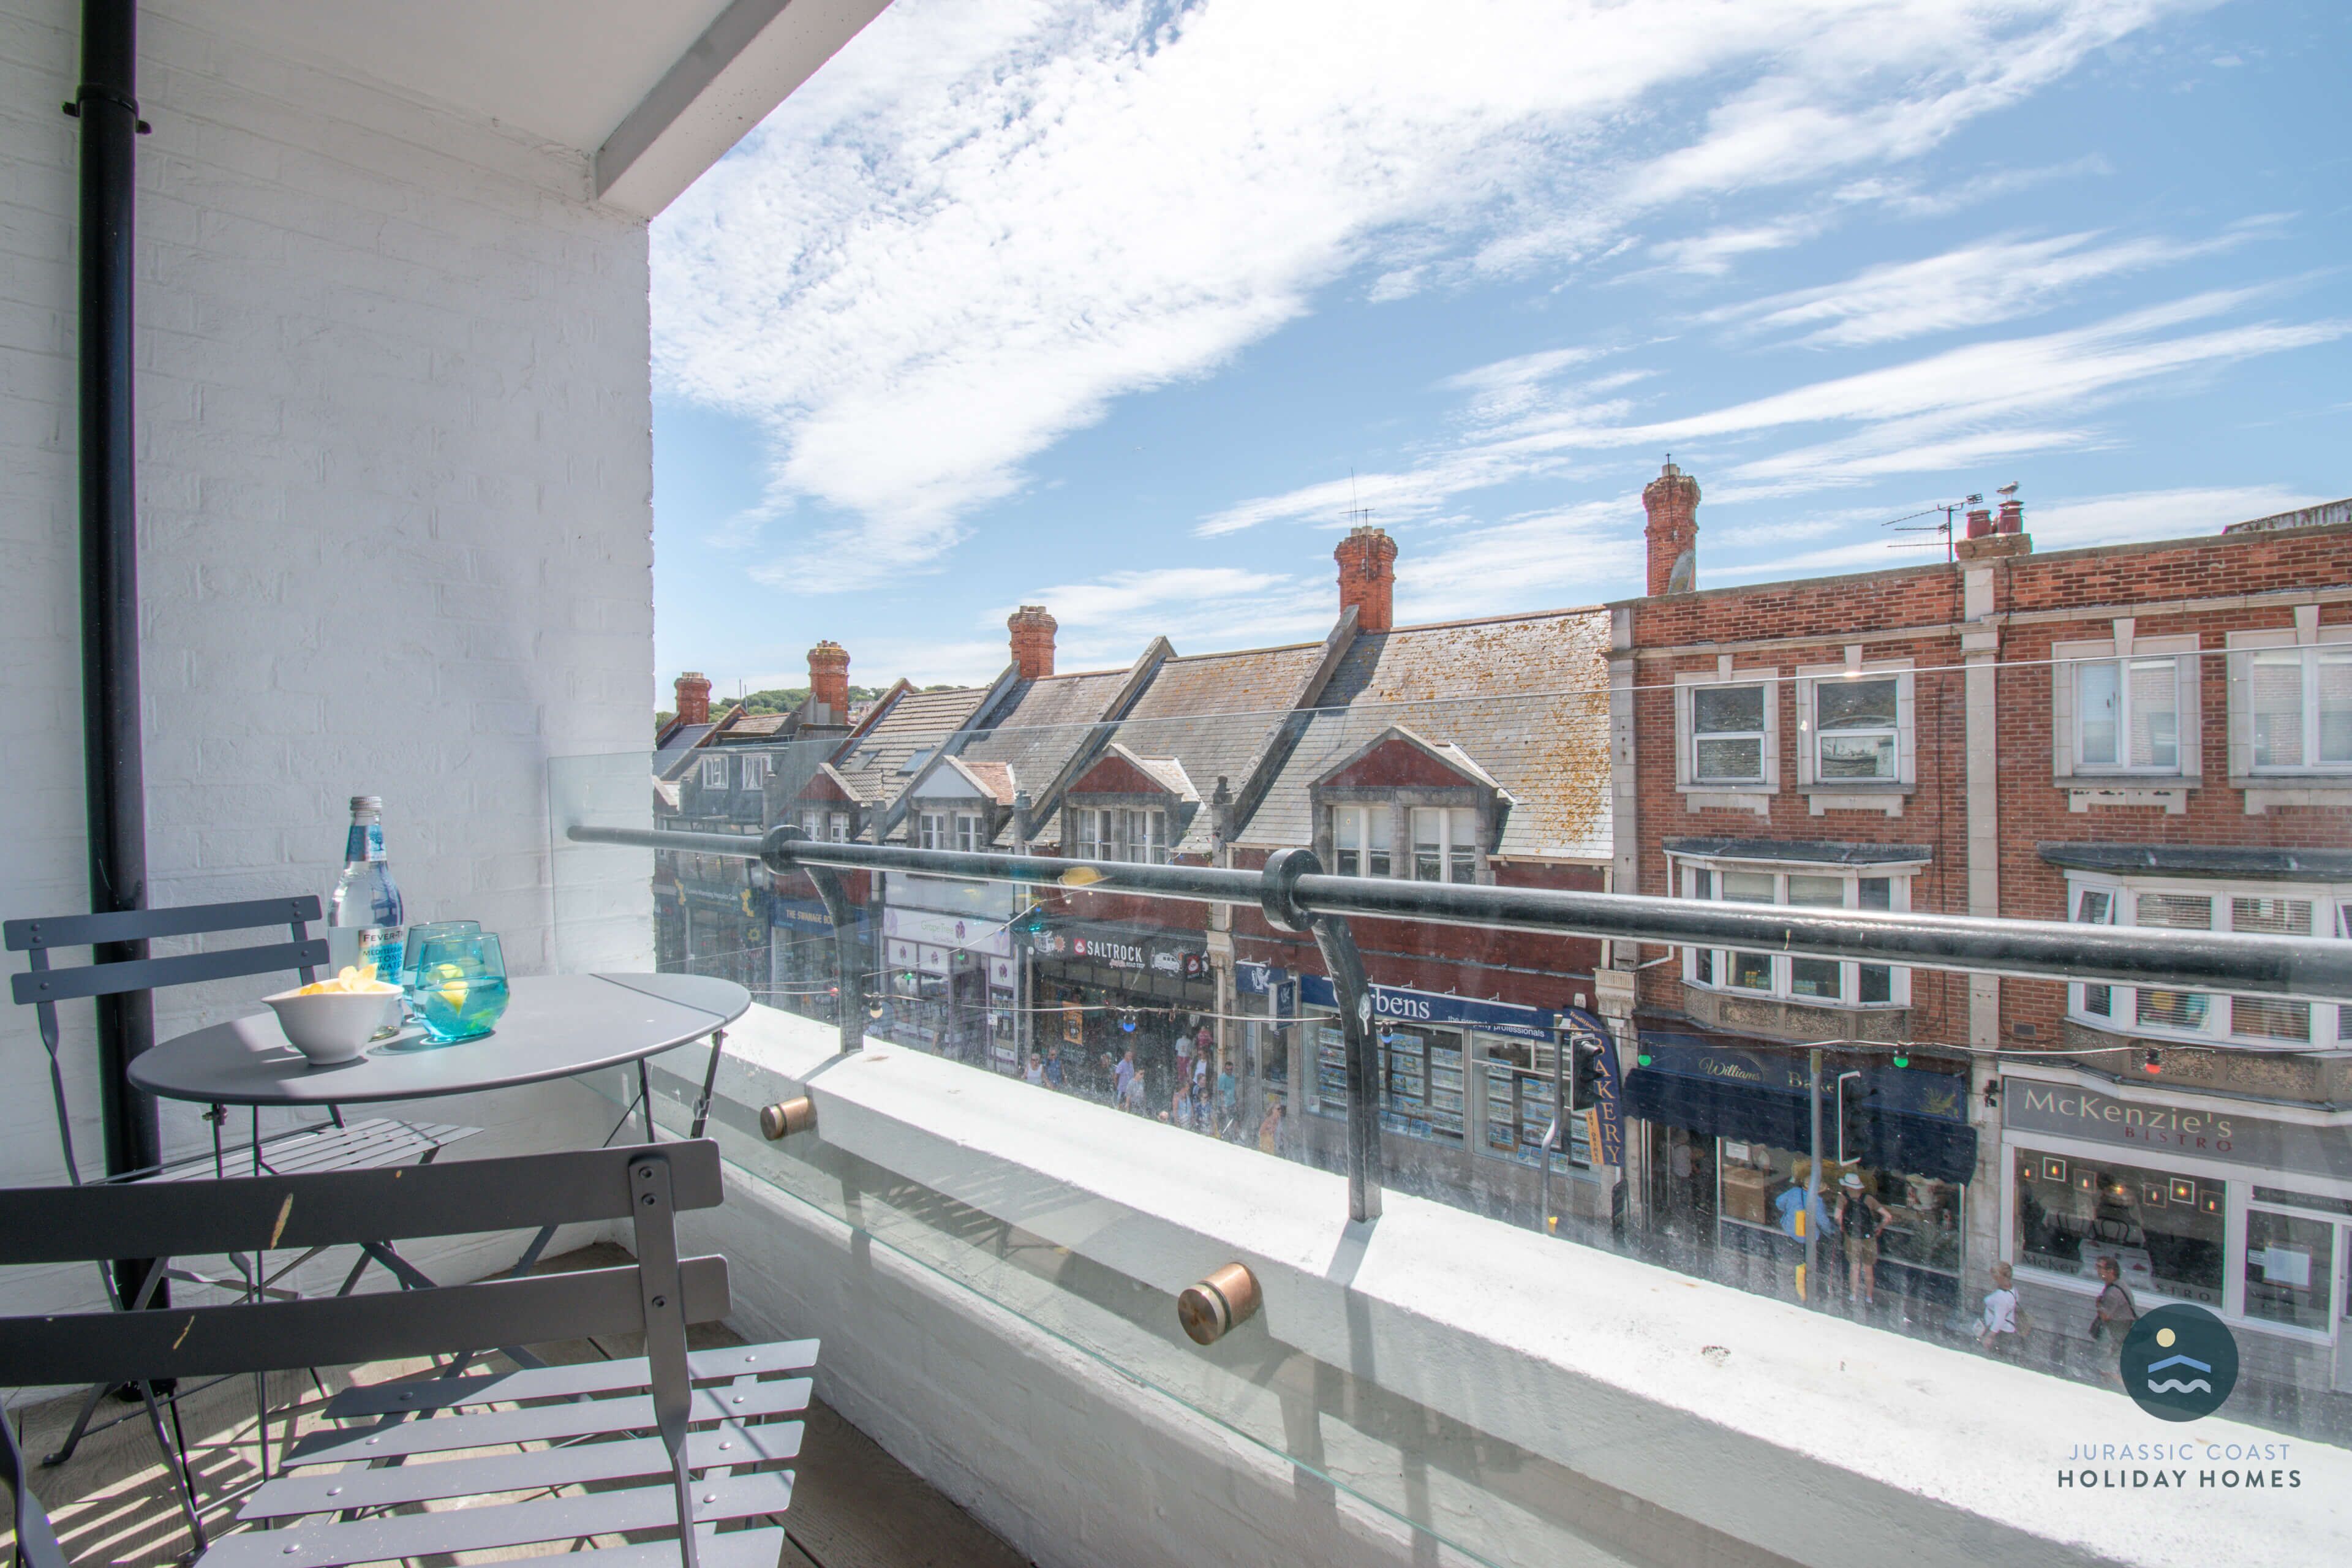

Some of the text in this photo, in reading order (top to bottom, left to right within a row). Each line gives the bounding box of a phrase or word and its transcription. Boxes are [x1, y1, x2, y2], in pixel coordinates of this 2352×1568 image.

[786, 909, 796, 919] THE
[797, 911, 822, 924] SWANAGE
[1087, 941, 1142, 962] SALTROCK
[378, 962, 402, 971] WATE
[1699, 1057, 1760, 1082] Williams
[2025, 1088, 2233, 1138] McKenzie's
[2125, 1127, 2233, 1152] BISTRO
